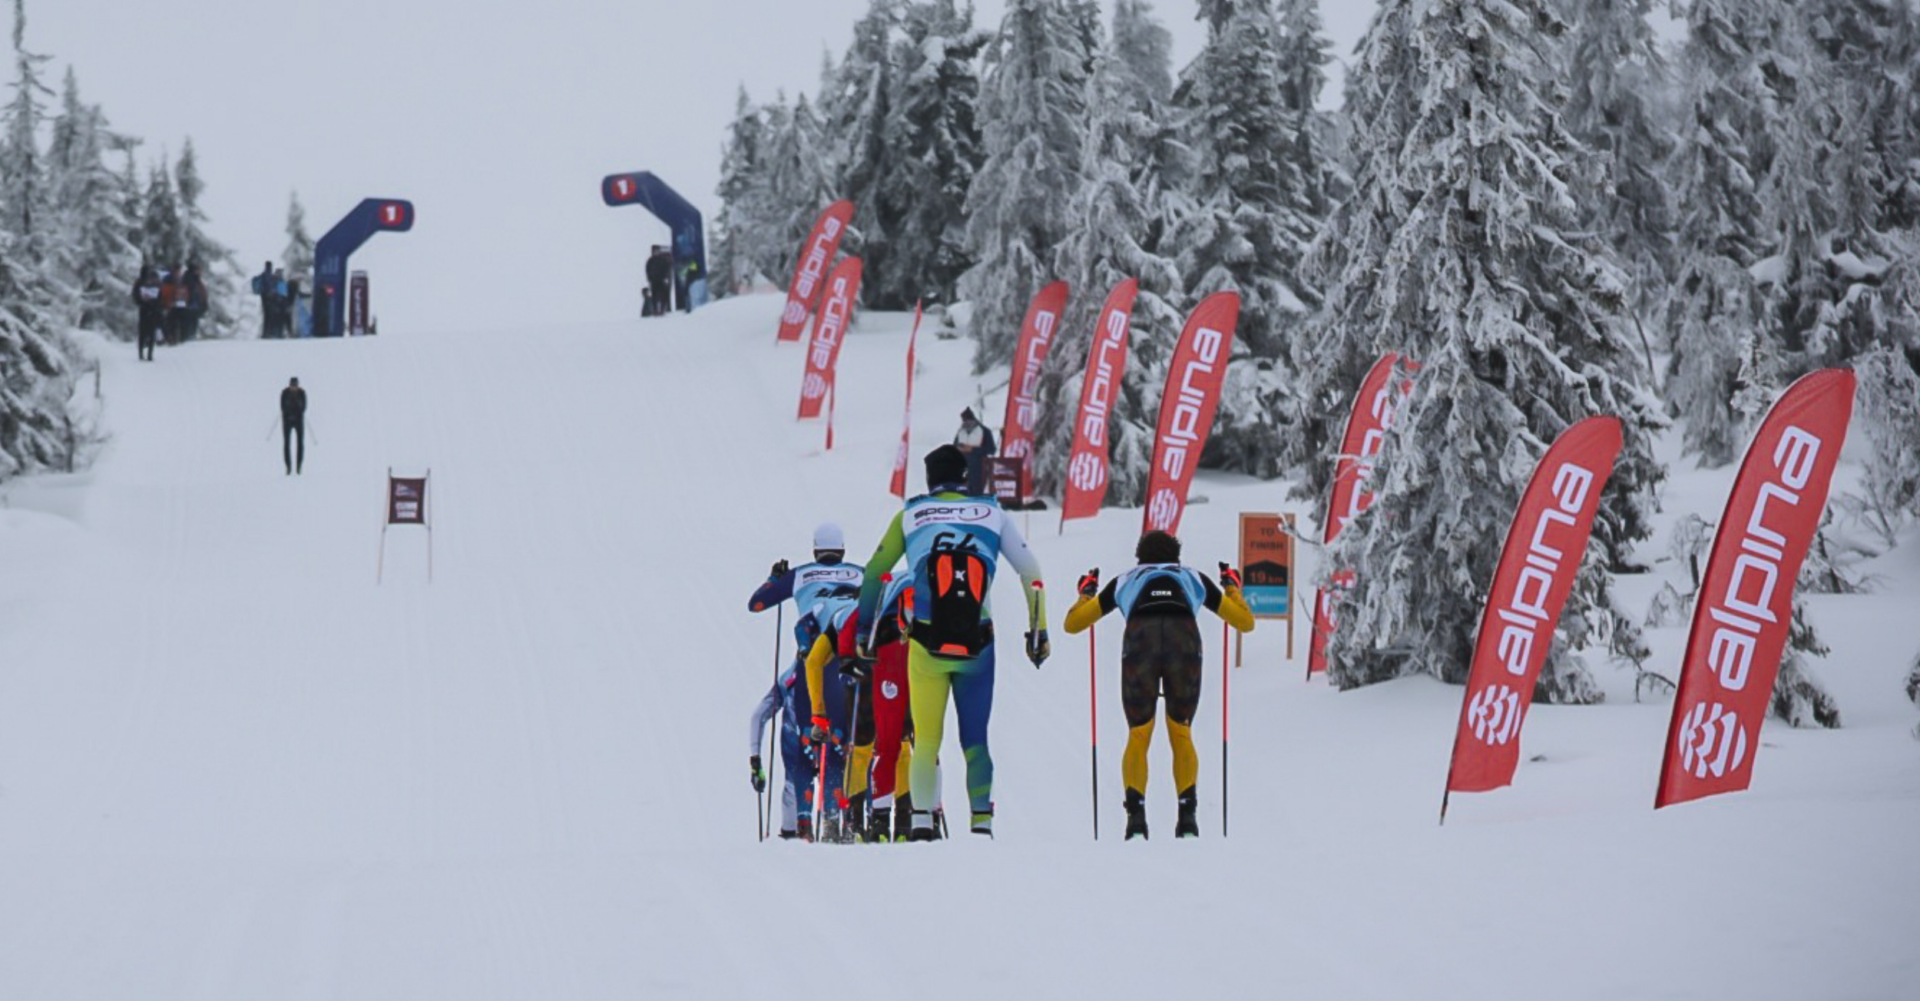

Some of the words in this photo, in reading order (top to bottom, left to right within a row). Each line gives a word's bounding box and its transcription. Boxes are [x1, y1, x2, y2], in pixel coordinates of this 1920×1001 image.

[385, 205, 397, 222] 1
[617, 179, 629, 196] 1
[796, 216, 841, 299] alpina
[811, 277, 848, 370] alpina
[1014, 310, 1055, 432] alpina
[1083, 309, 1128, 447] alpina
[1161, 326, 1223, 481] alpina
[914, 507, 967, 519] sport
[1249, 541, 1284, 551] FINISH
[1260, 527, 1275, 537] TO
[1250, 571, 1267, 584] 19
[1497, 462, 1594, 676] alpina
[1707, 425, 1822, 691] alpina
